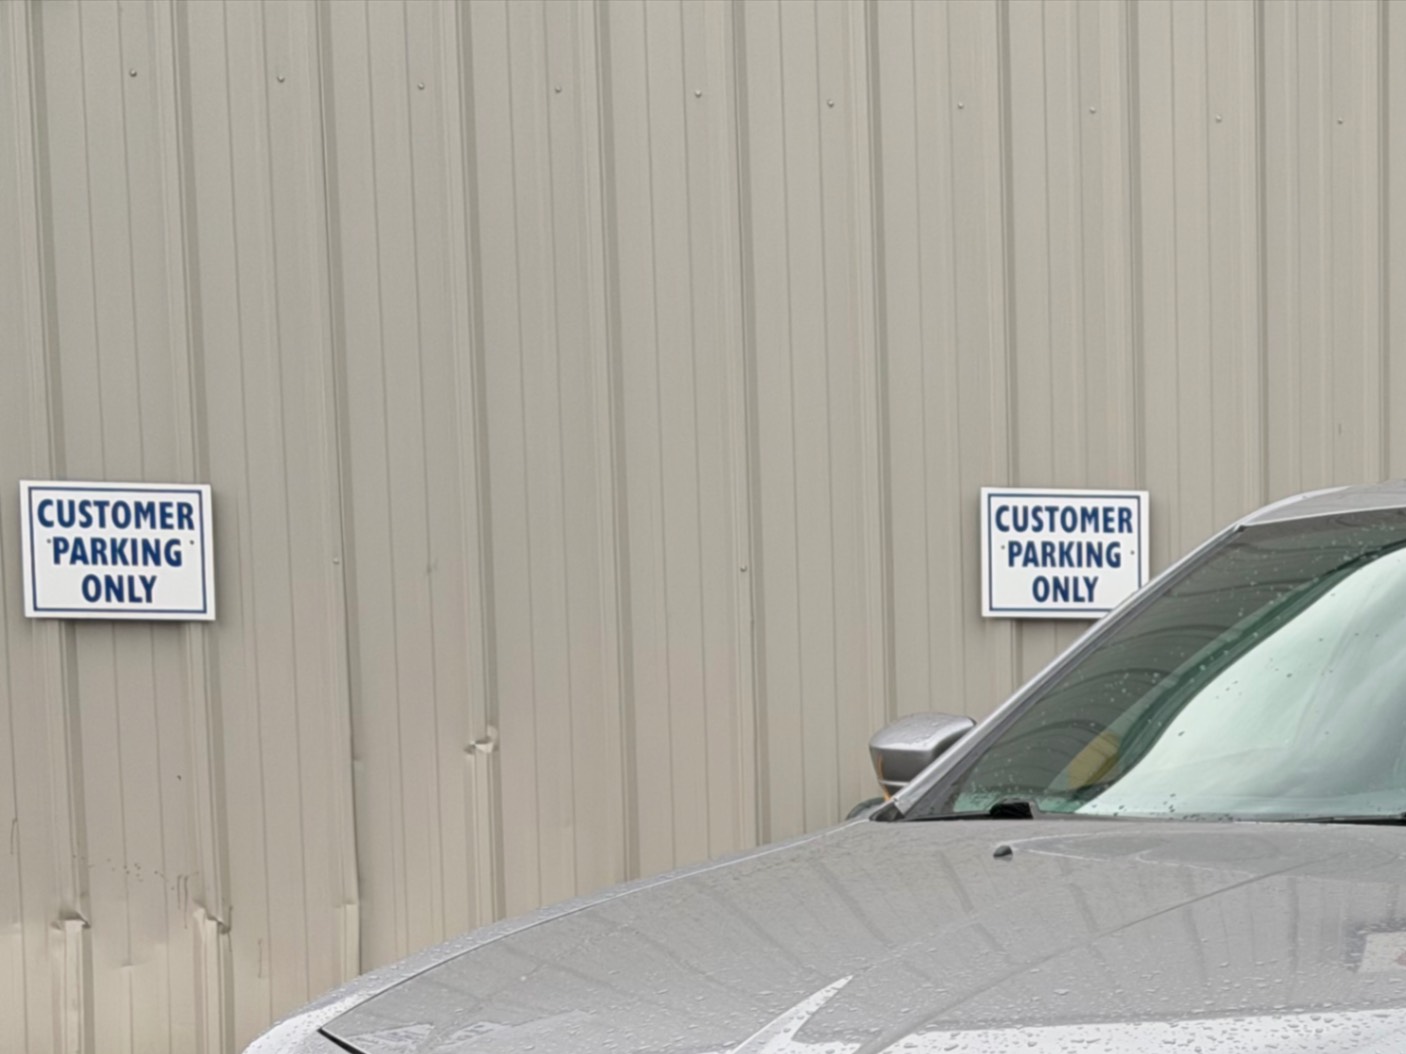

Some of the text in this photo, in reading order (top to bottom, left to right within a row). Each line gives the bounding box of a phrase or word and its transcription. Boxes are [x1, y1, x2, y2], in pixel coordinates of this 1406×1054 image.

[37, 499, 195, 530] CUSTOMER
[995, 505, 1133, 534] CUSTOMER
[52, 536, 183, 568] PARKING
[1008, 540, 1121, 568] PARKING
[81, 573, 157, 604] ONLY
[1032, 575, 1099, 603] ONLY
